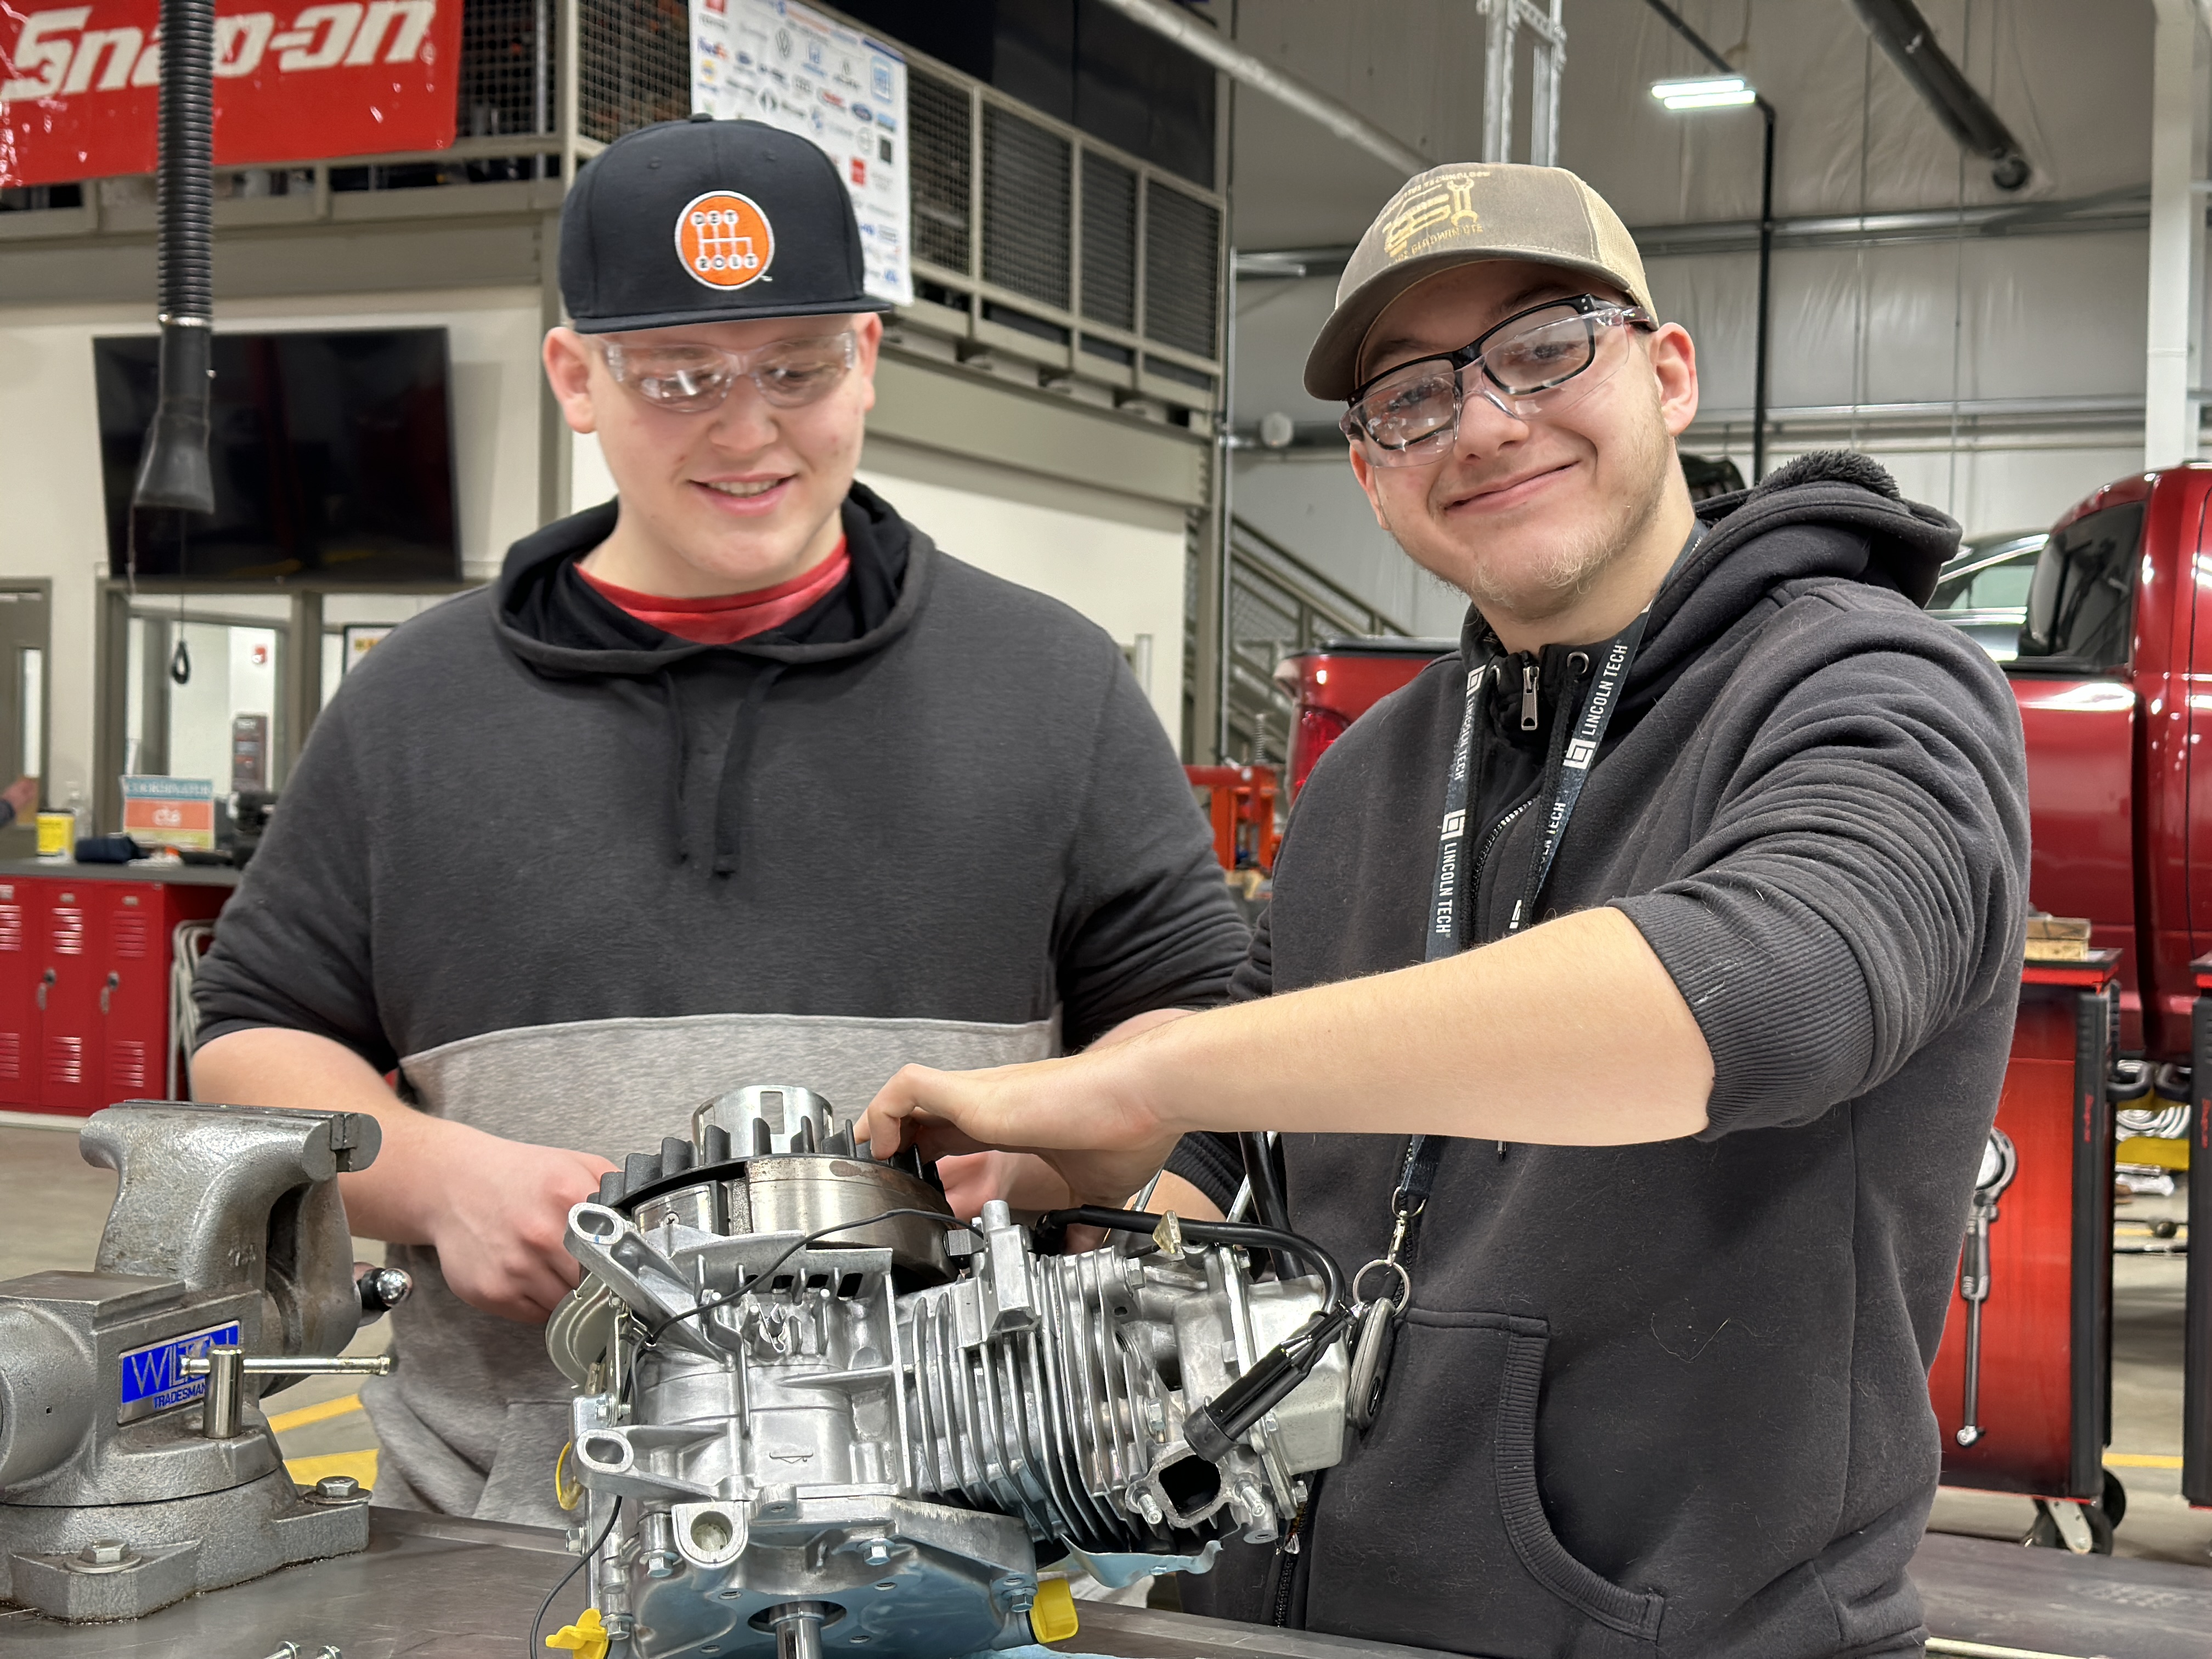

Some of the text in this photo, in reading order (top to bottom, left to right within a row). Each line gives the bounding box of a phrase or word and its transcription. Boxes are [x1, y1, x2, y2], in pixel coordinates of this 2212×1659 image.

[1581, 644, 1628, 736] LINCOLN TECH
[1454, 748, 1468, 781] TECH
[1435, 842, 1457, 933] LINCOLN TECH
[131, 1329, 230, 1395] WILT
